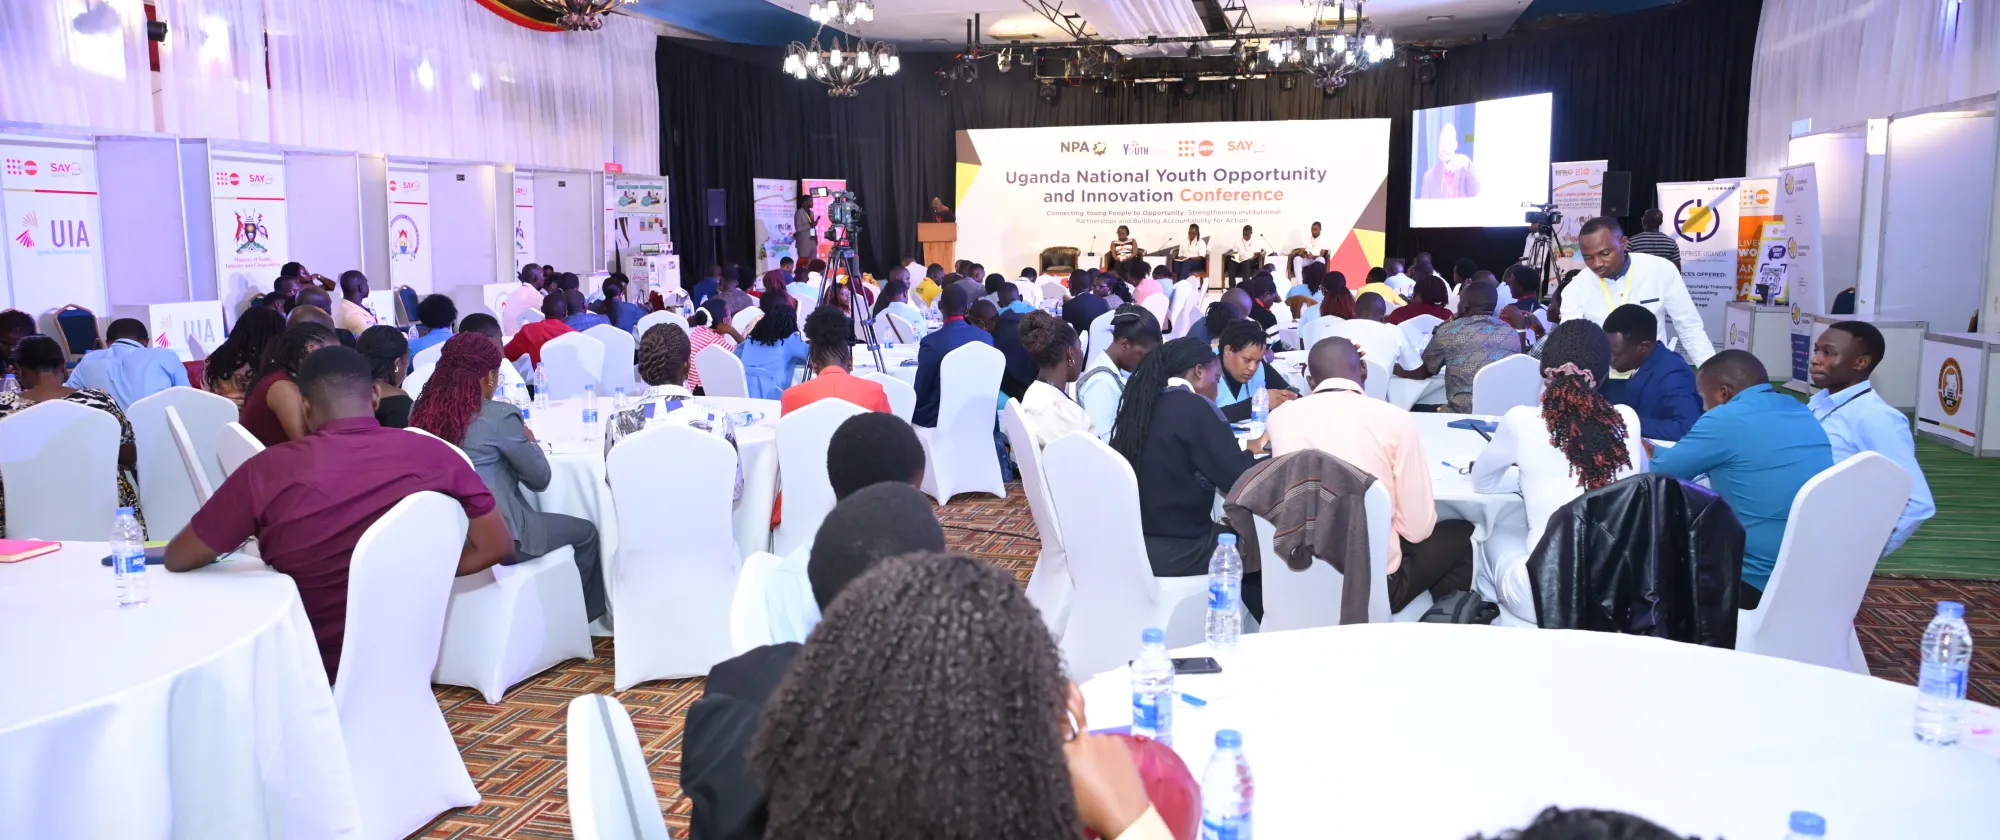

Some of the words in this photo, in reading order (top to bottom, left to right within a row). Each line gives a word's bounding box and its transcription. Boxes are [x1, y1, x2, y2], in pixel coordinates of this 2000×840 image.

[1060, 141, 1090, 152] NPA
[1227, 141, 1253, 151] SAY
[50, 163, 71, 172] SAY
[249, 174, 265, 183] SAY
[1006, 170, 1070, 186] Uganda
[1077, 169, 1149, 183] National
[1156, 168, 1207, 182] Youth
[1213, 166, 1327, 184] Opportunity
[1043, 189, 1075, 202] and
[1081, 189, 1173, 202] Innovation
[1179, 188, 1284, 202] Conference
[50, 219, 90, 248] UIA
